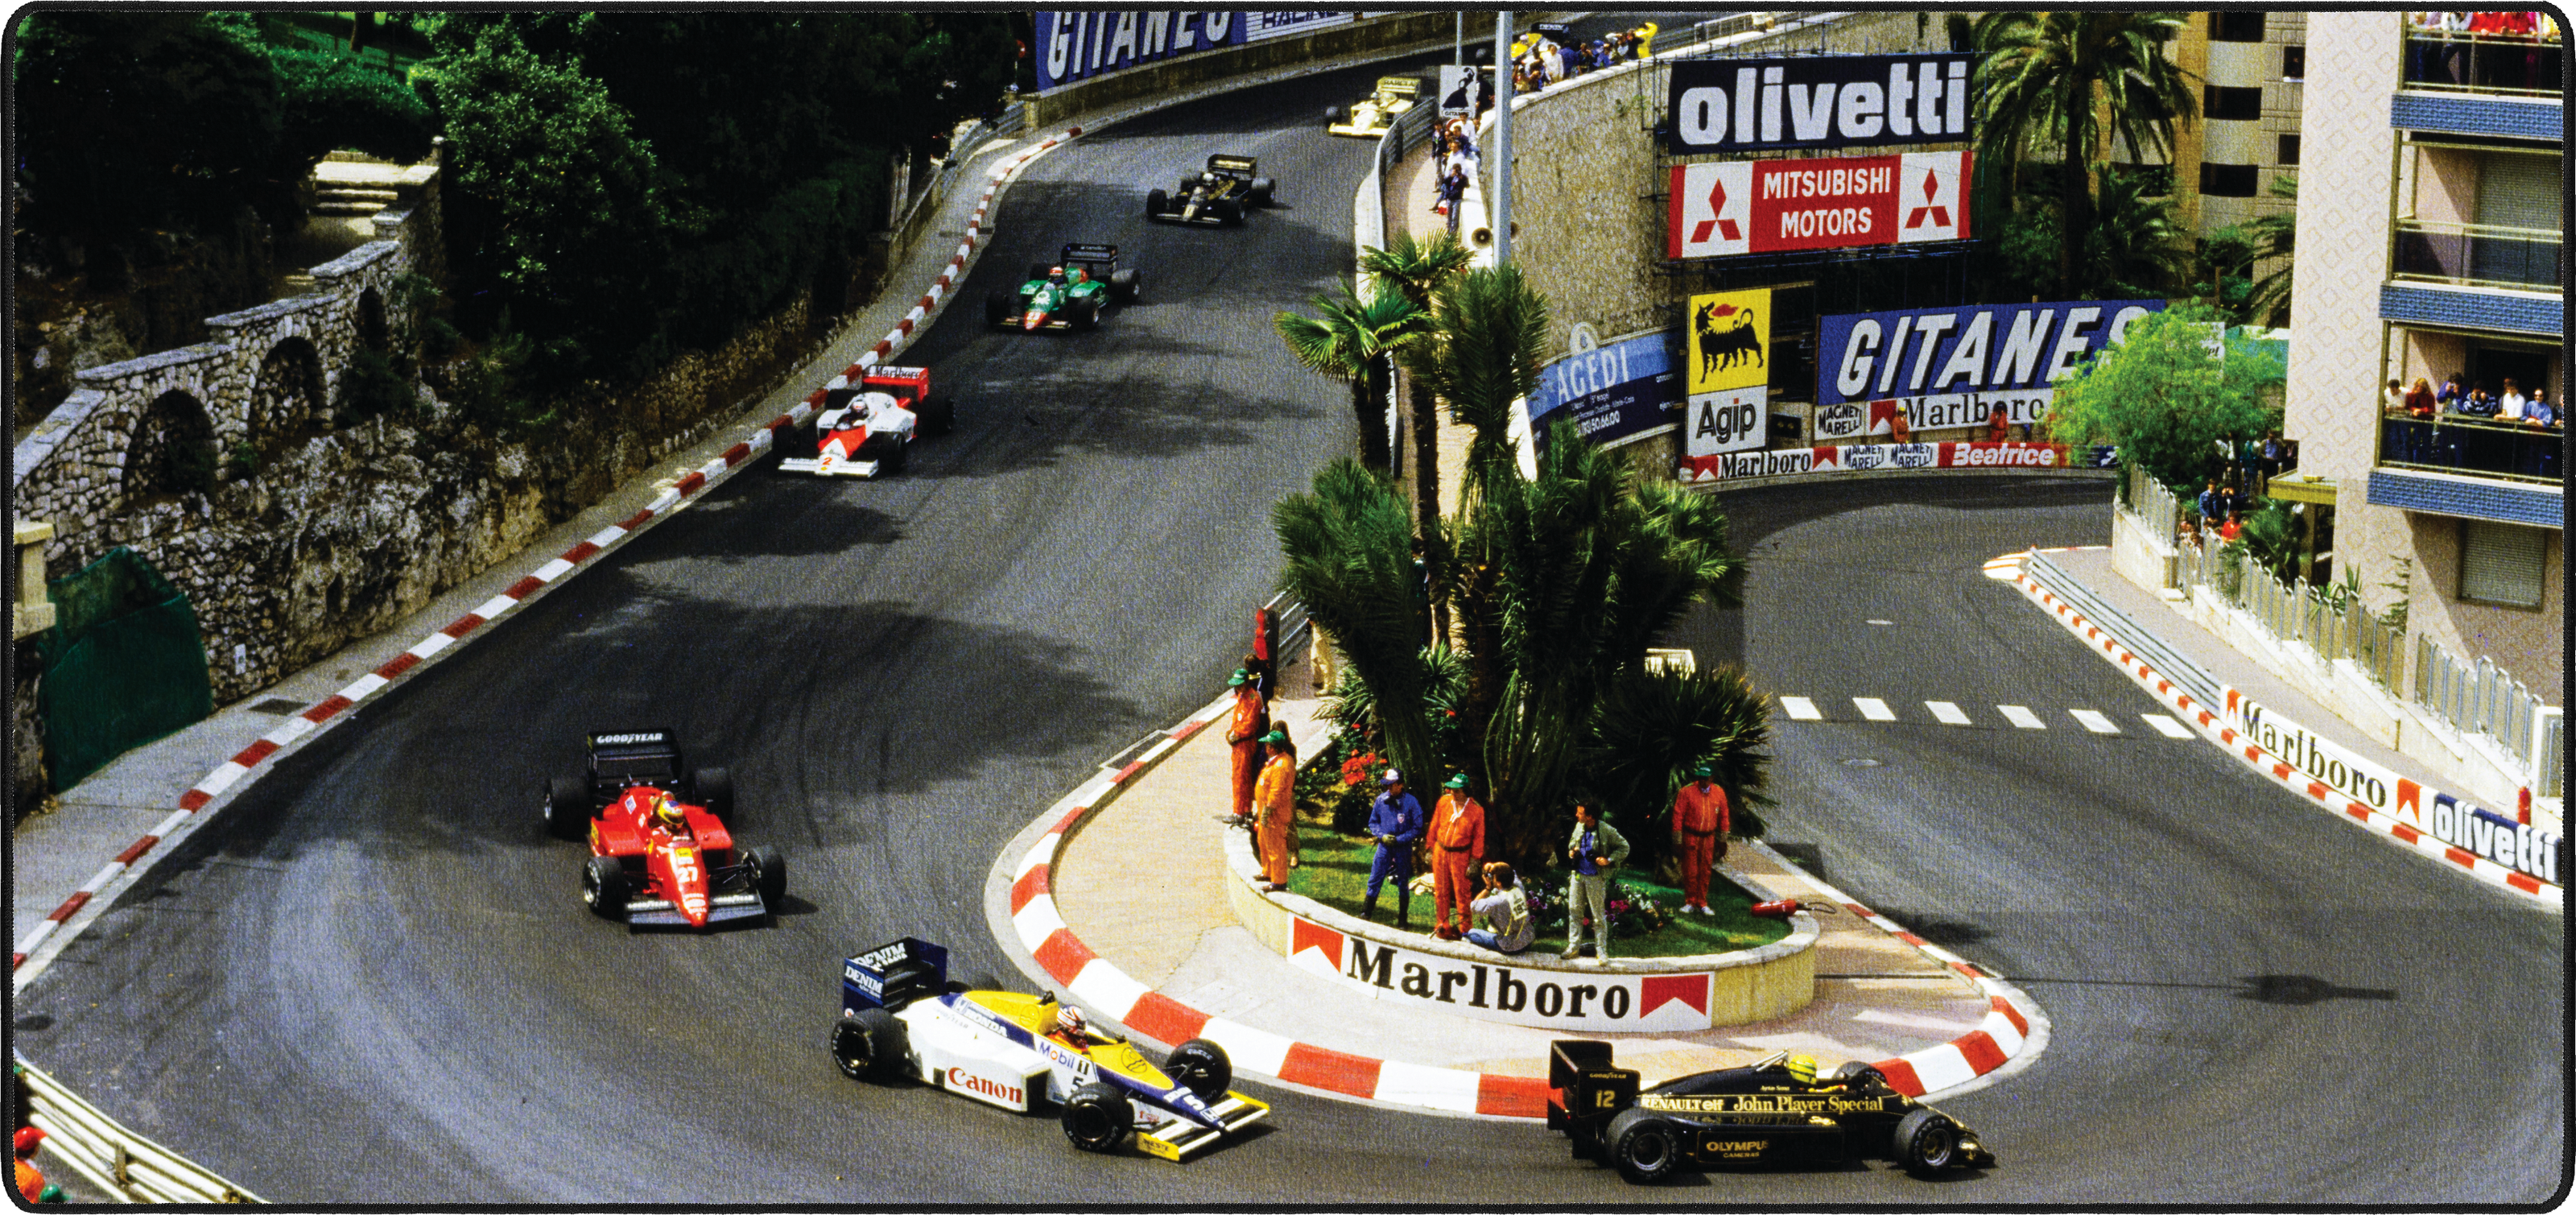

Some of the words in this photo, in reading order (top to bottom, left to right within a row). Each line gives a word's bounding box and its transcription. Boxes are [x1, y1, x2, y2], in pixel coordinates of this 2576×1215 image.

[1679, 61, 1967, 146] olivetti
[1763, 167, 1892, 200] MITSUBISHI
[1781, 206, 1873, 239] MOTORS
[1557, 345, 1629, 405] AGEDI
[1696, 397, 1757, 444] Agip
[1904, 393, 2045, 428] Marlbro
[822, 457, 832, 466] 2
[1719, 448, 1811, 479] Marlboro
[1952, 443, 2055, 466] Beatrice
[597, 733, 663, 745] GOODYEAR
[2242, 699, 2387, 809] Marlboro
[2435, 800, 2557, 882] olivetti
[677, 866, 699, 883] 27
[852, 942, 906, 965] DENIM
[844, 965, 884, 994] DENIM
[1347, 937, 1630, 1020] Marlboro
[965, 1009, 1008, 1038] HONDA
[1038, 1042, 1075, 1070] Mobil
[948, 1067, 1022, 1104] Canon
[1589, 1072, 1627, 1080] GOODYEAR
[1183, 1094, 1205, 1110] 5
[1596, 1090, 1616, 1108] 12
[1641, 1098, 1702, 1110] RENAULT
[1703, 1099, 1724, 1111] elf
[1733, 1096, 1774, 1112] John
[1777, 1096, 1826, 1114] Player
[1828, 1096, 1884, 1114] Special
